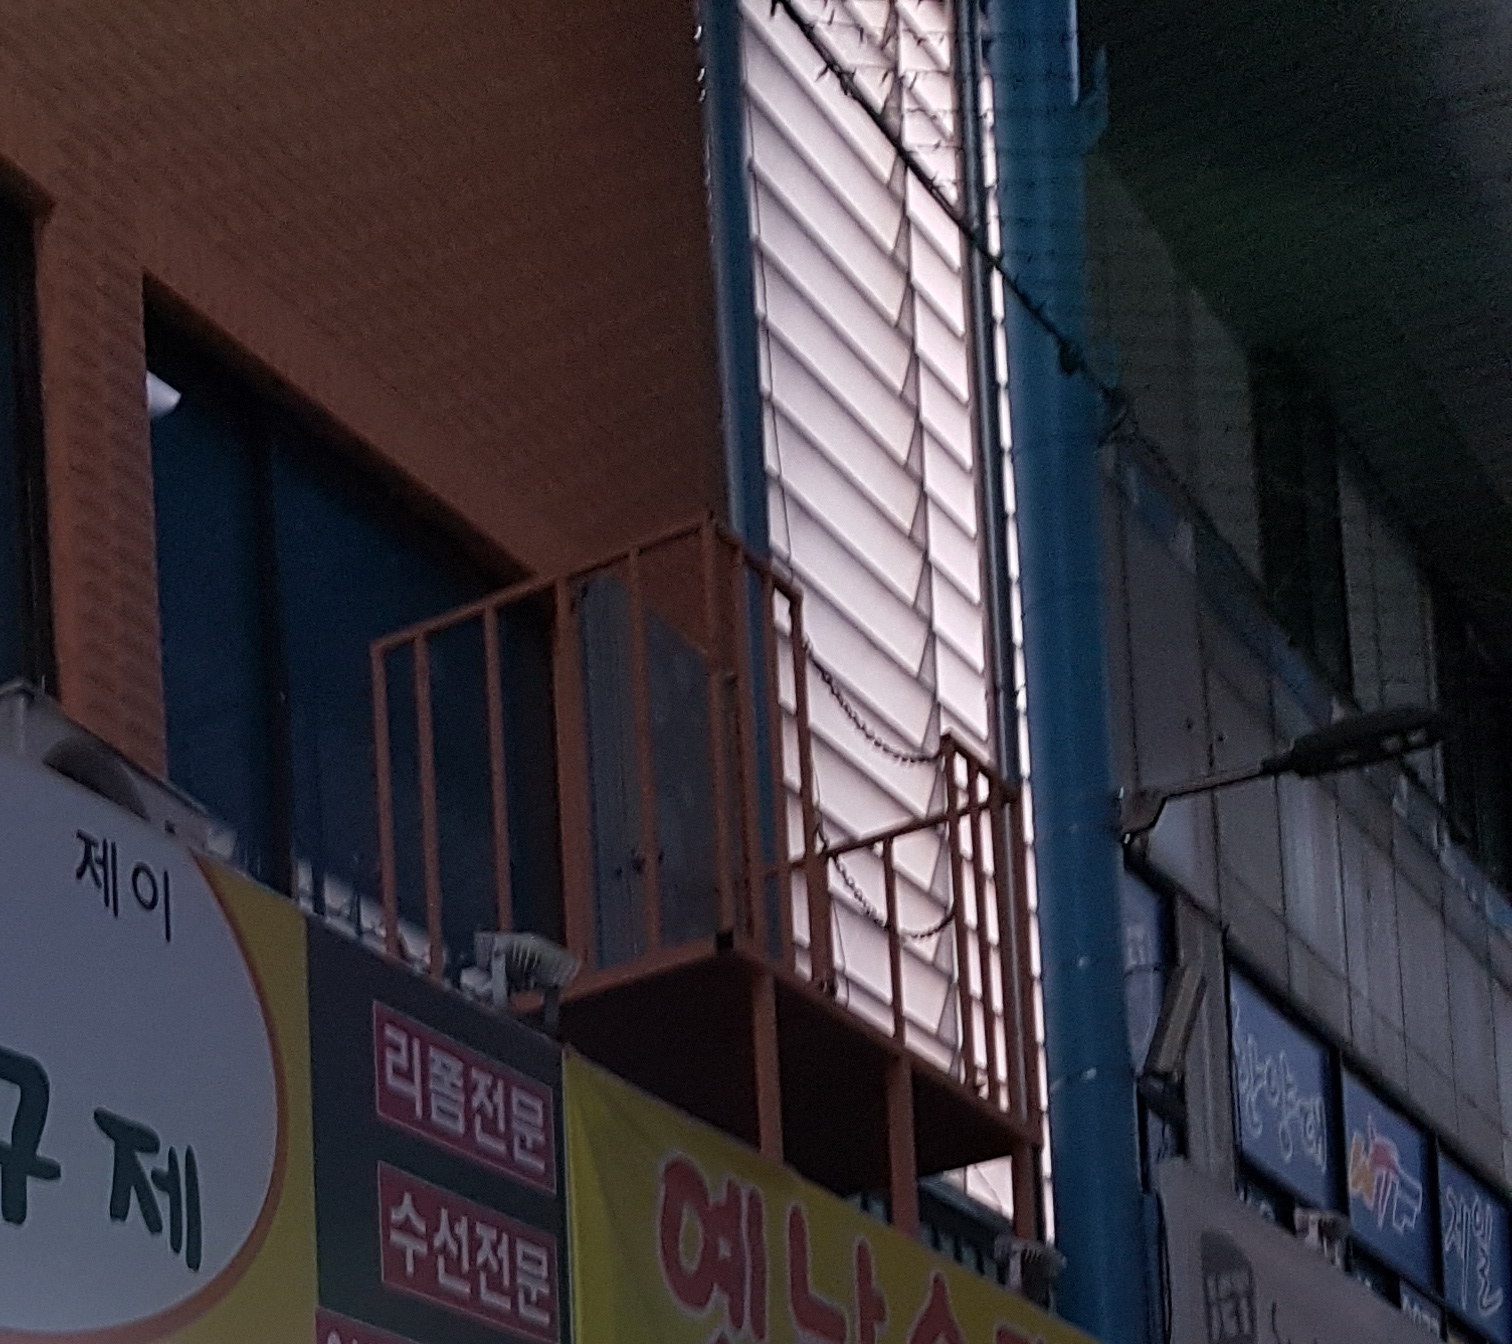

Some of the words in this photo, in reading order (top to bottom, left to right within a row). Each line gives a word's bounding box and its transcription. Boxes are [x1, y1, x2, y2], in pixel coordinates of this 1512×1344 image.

[74, 827, 173, 942] 제이
[384, 1022, 547, 1173] 리폼전문
[389, 1191, 551, 1328] 수선전문
